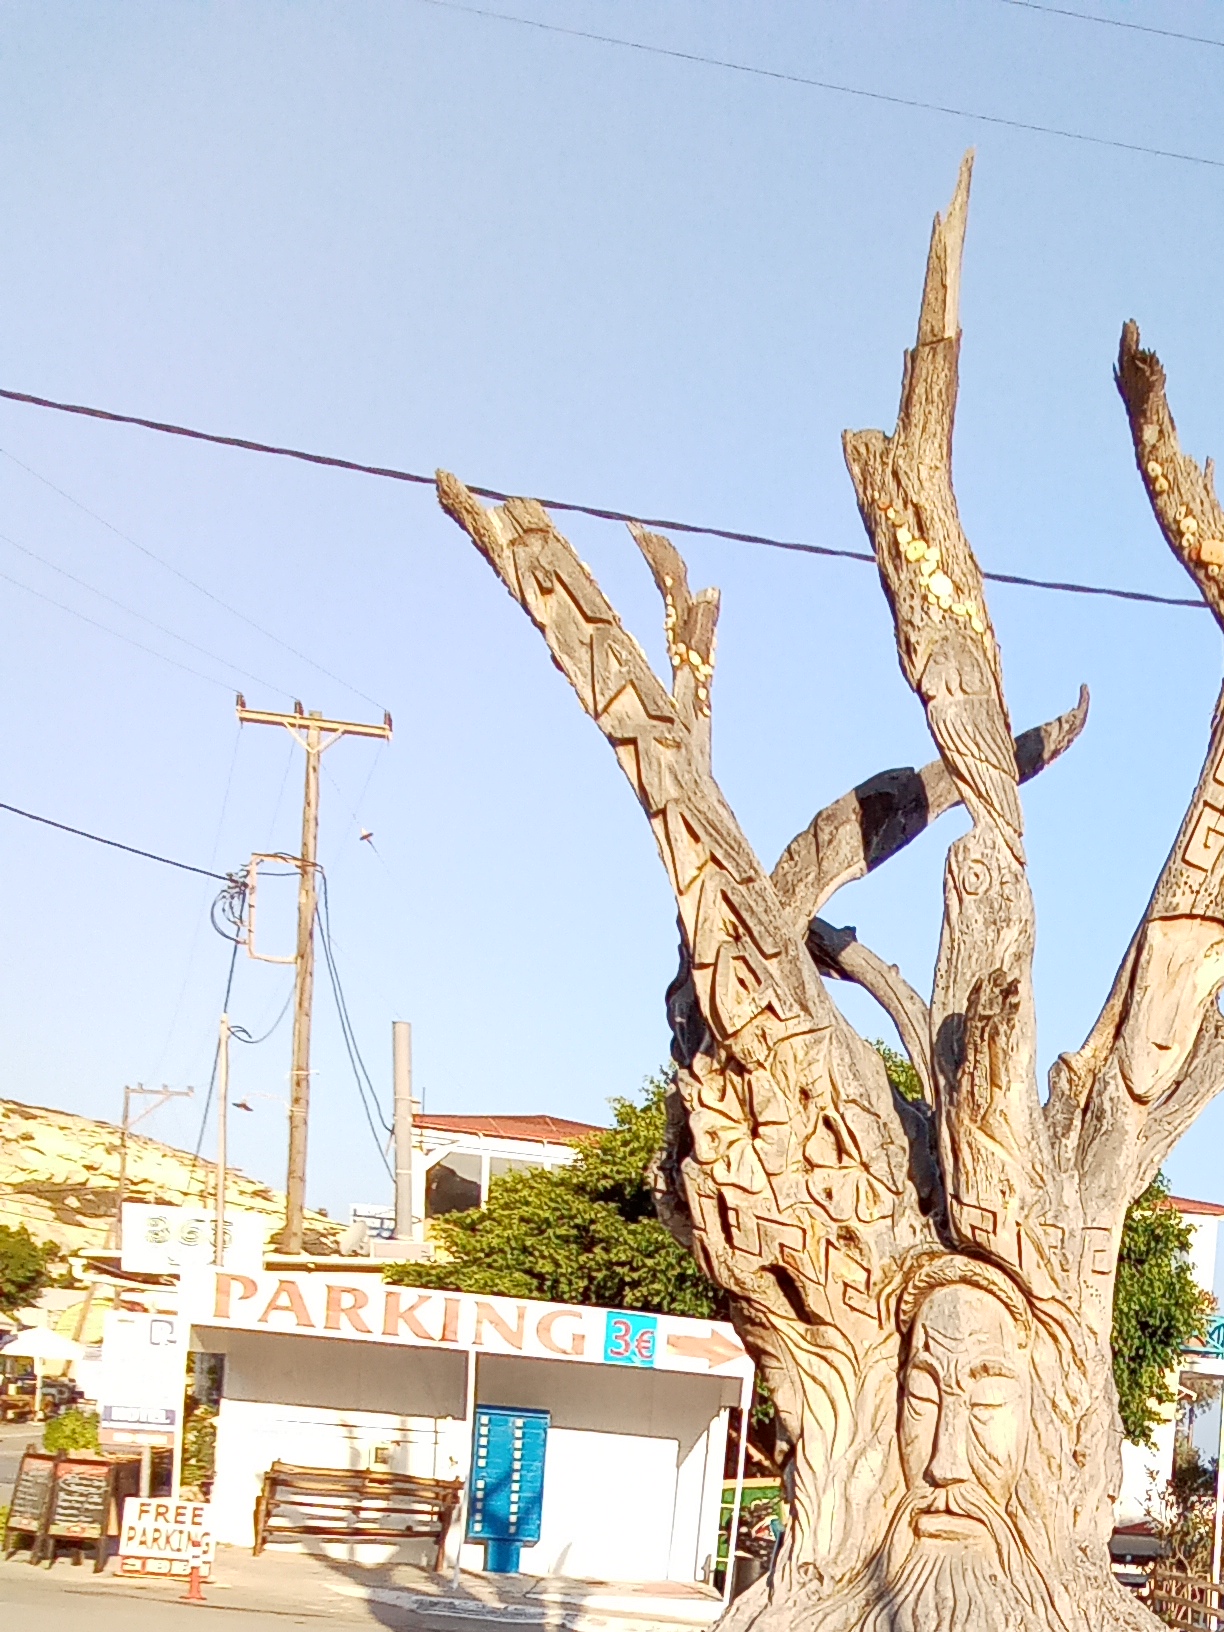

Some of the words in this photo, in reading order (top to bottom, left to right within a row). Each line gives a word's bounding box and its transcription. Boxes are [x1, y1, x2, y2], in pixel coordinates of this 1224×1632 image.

[213, 1271, 586, 1356] PARKING
[608, 1319, 656, 1361] 3€
[137, 1502, 205, 1526] FREE
[126, 1525, 211, 1555] PARKING
